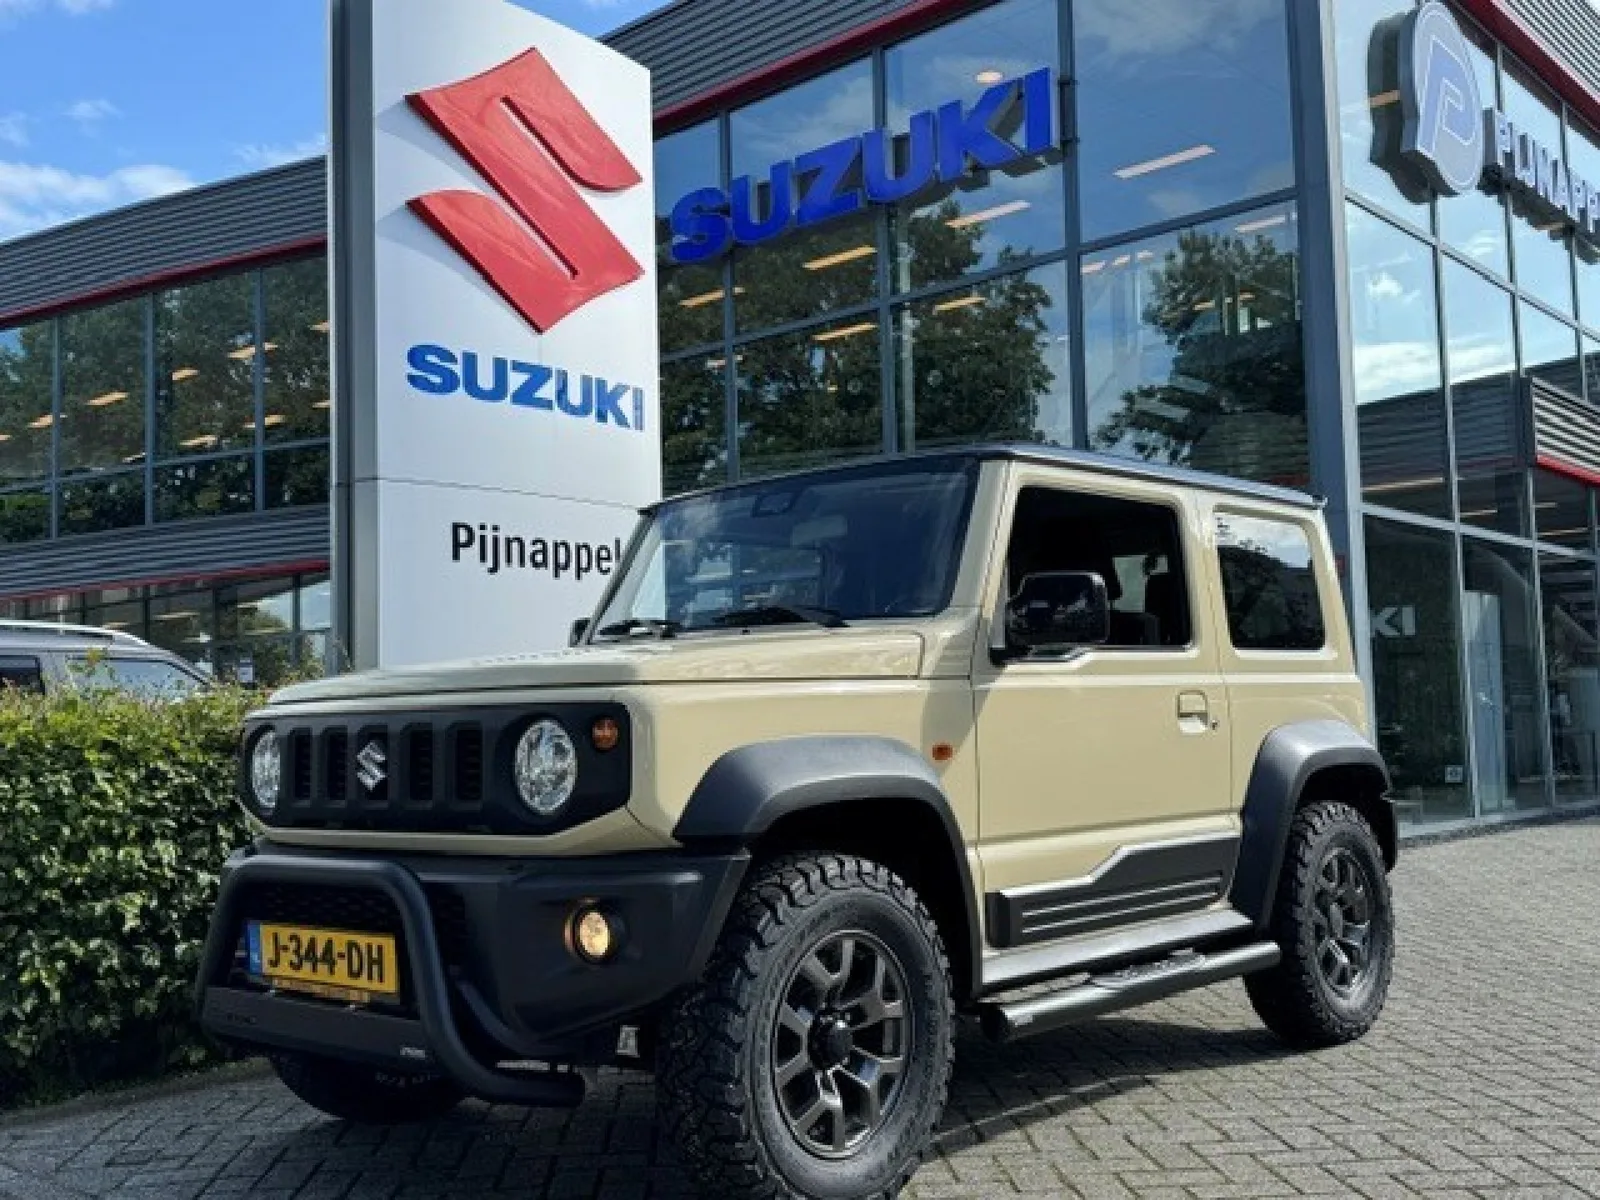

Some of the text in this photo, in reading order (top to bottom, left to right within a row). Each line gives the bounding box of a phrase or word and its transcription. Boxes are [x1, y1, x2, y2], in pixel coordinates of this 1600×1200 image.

[670, 67, 1053, 264] SUZUKI
[406, 344, 645, 432] SUZUKI
[268, 931, 386, 984] J-344-DH
